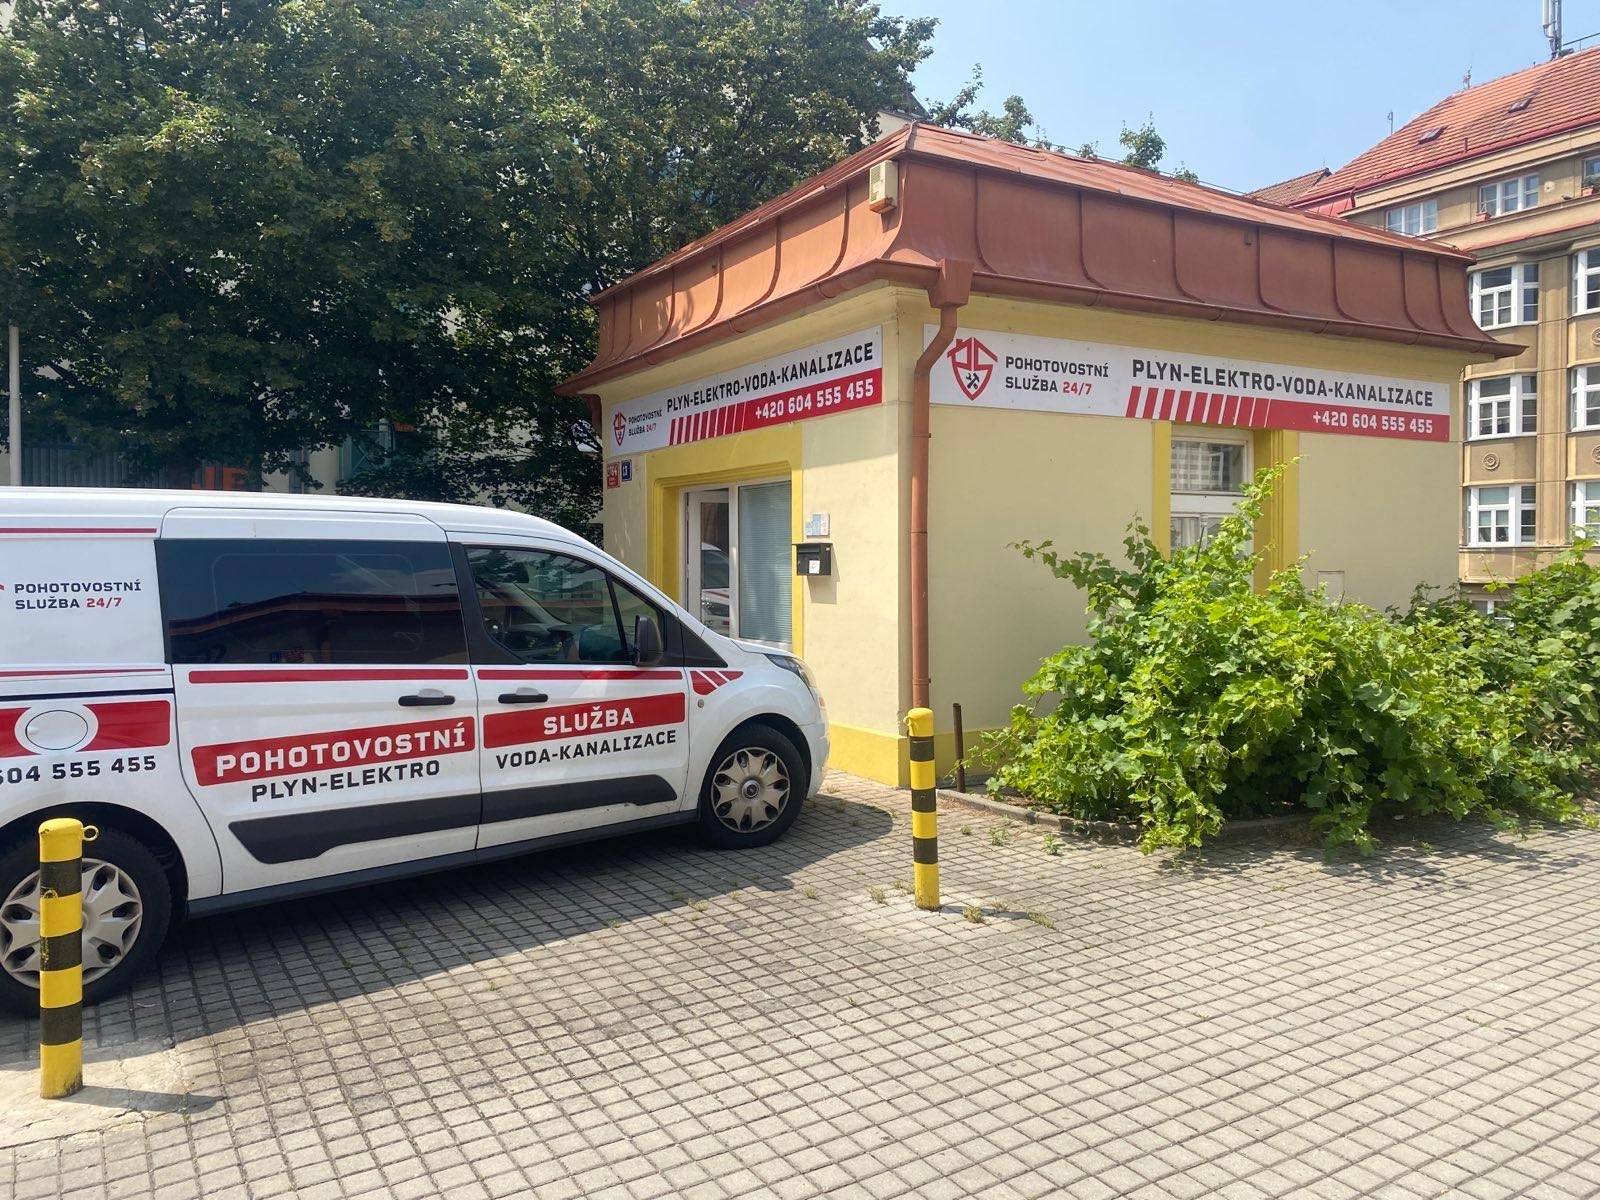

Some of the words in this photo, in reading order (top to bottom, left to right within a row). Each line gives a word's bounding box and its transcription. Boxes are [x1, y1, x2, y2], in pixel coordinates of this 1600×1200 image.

[667, 342, 874, 413] PLYN-ELEKTRO-VODA-KANALIZACE
[1005, 356, 1109, 378] POHOTOVOSTNÍ
[1005, 375, 1058, 393] SLUŽBA
[1062, 382, 1092, 395] 24/7
[1132, 359, 1433, 407] PLYN-ELEKTRO-VODA-KANALIZACE
[755, 400, 784, 419] +420
[788, 394, 812, 414] 604
[816, 386, 841, 407] 555
[847, 378, 874, 400] 455
[628, 408, 663, 424] POHOTOVOSTNÍ
[628, 424, 645, 437] SLUŽBA
[1313, 411, 1347, 427] +420
[1352, 413, 1377, 429] 604
[1381, 416, 1405, 431] 555
[1409, 418, 1433, 434] 455
[14, 578, 142, 594] POHOTOVOSTNÍ
[15, 595, 80, 610] SLUŽBA
[86, 597, 123, 609] 24/7
[543, 706, 635, 736] SLUŽBA
[216, 722, 466, 778] POHOTOVOSTNÍ
[496, 730, 677, 770] VODA-KANALIZACE
[0, 764, 41, 785] 04
[52, 760, 102, 780] 555
[111, 755, 157, 774] 455
[252, 760, 440, 802] PLYN-ELEKTRO
